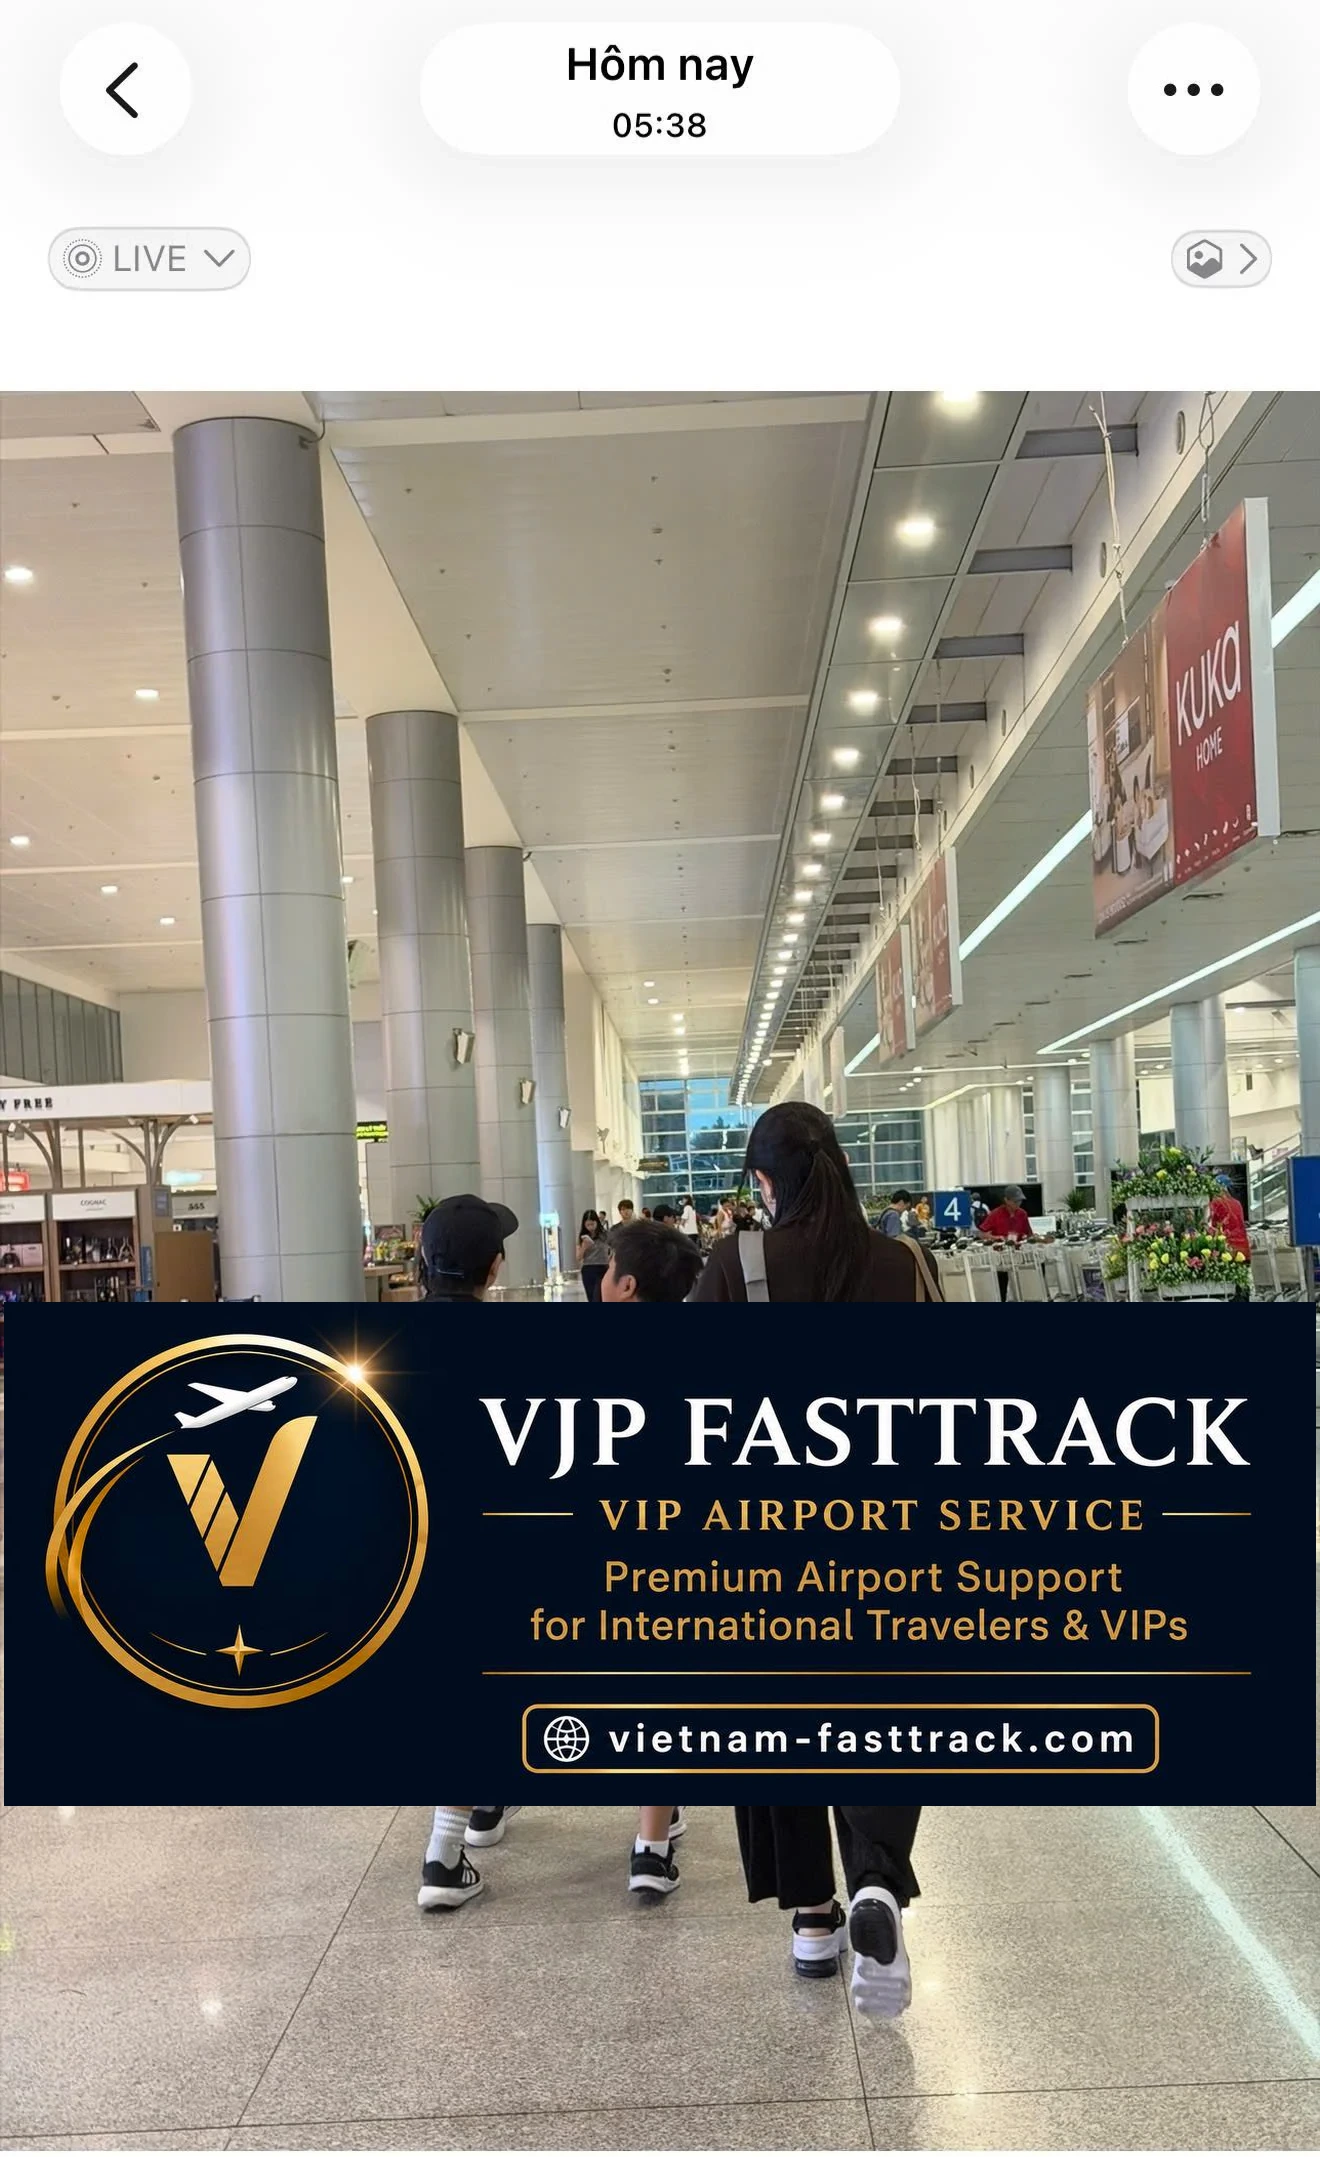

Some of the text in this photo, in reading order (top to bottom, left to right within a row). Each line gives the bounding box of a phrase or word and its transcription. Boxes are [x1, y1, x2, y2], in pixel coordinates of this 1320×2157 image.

[1196, 726, 1223, 772] HOME
[14, 1097, 53, 1110] FREE
[943, 1196, 962, 1221] 4
